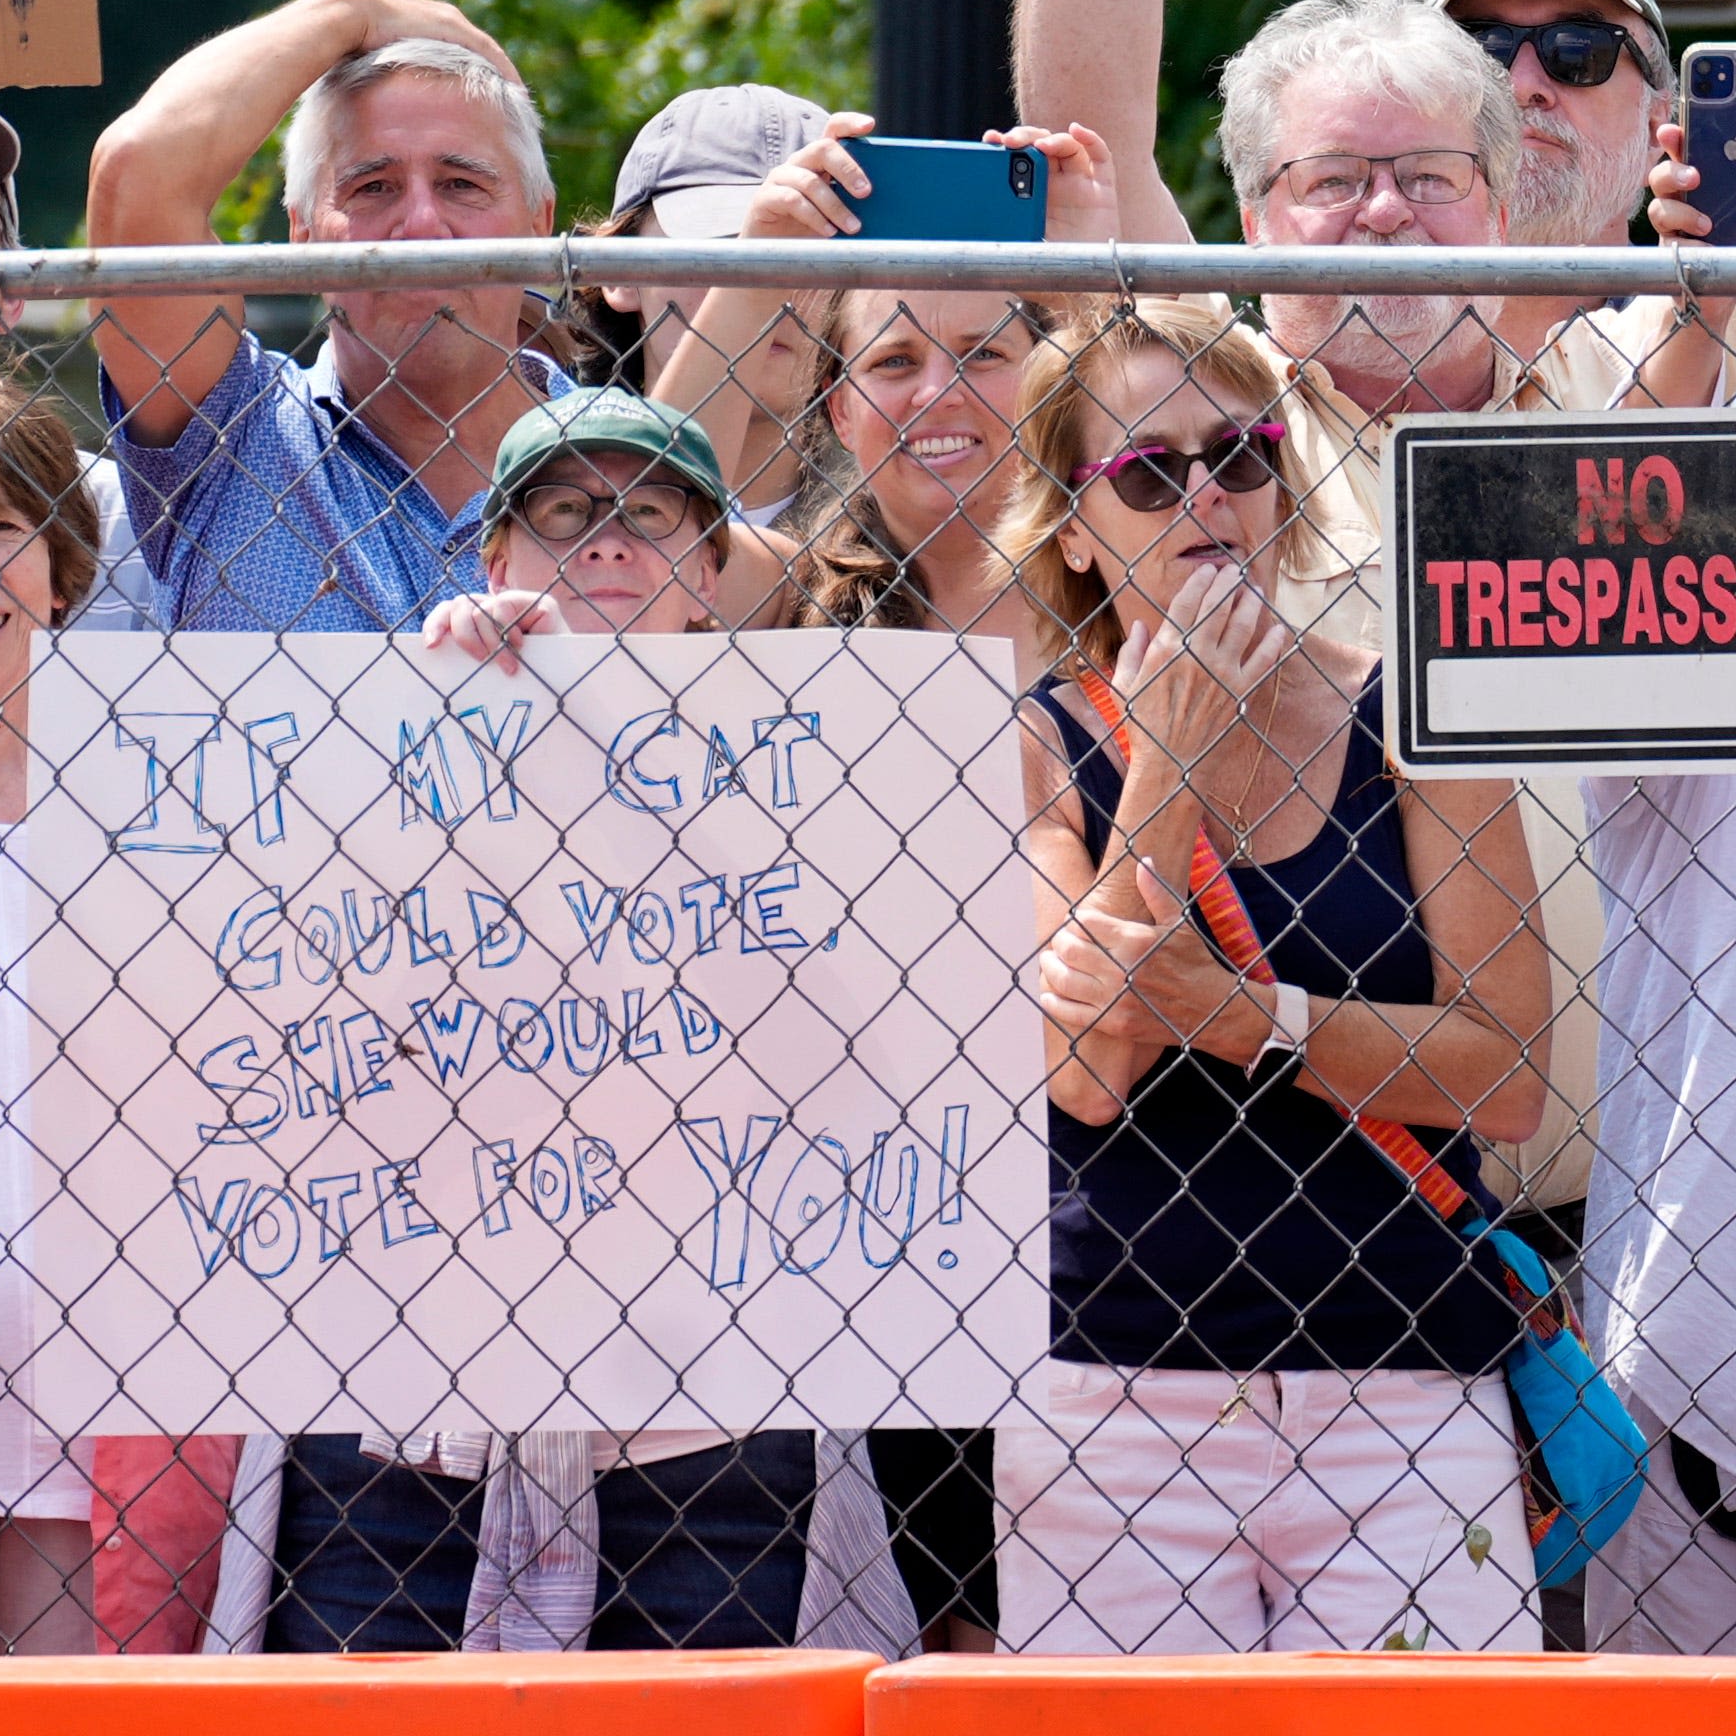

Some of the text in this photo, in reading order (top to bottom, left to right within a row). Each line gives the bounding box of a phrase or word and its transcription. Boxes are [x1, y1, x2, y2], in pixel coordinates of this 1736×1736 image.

[1576, 455, 1684, 545] NO
[108, 700, 821, 854] IF MY CAT
[215, 884, 526, 990] COULD
[196, 987, 722, 1145] SHE WOULD
[174, 1104, 969, 1295] VOTE FOR YOU!
